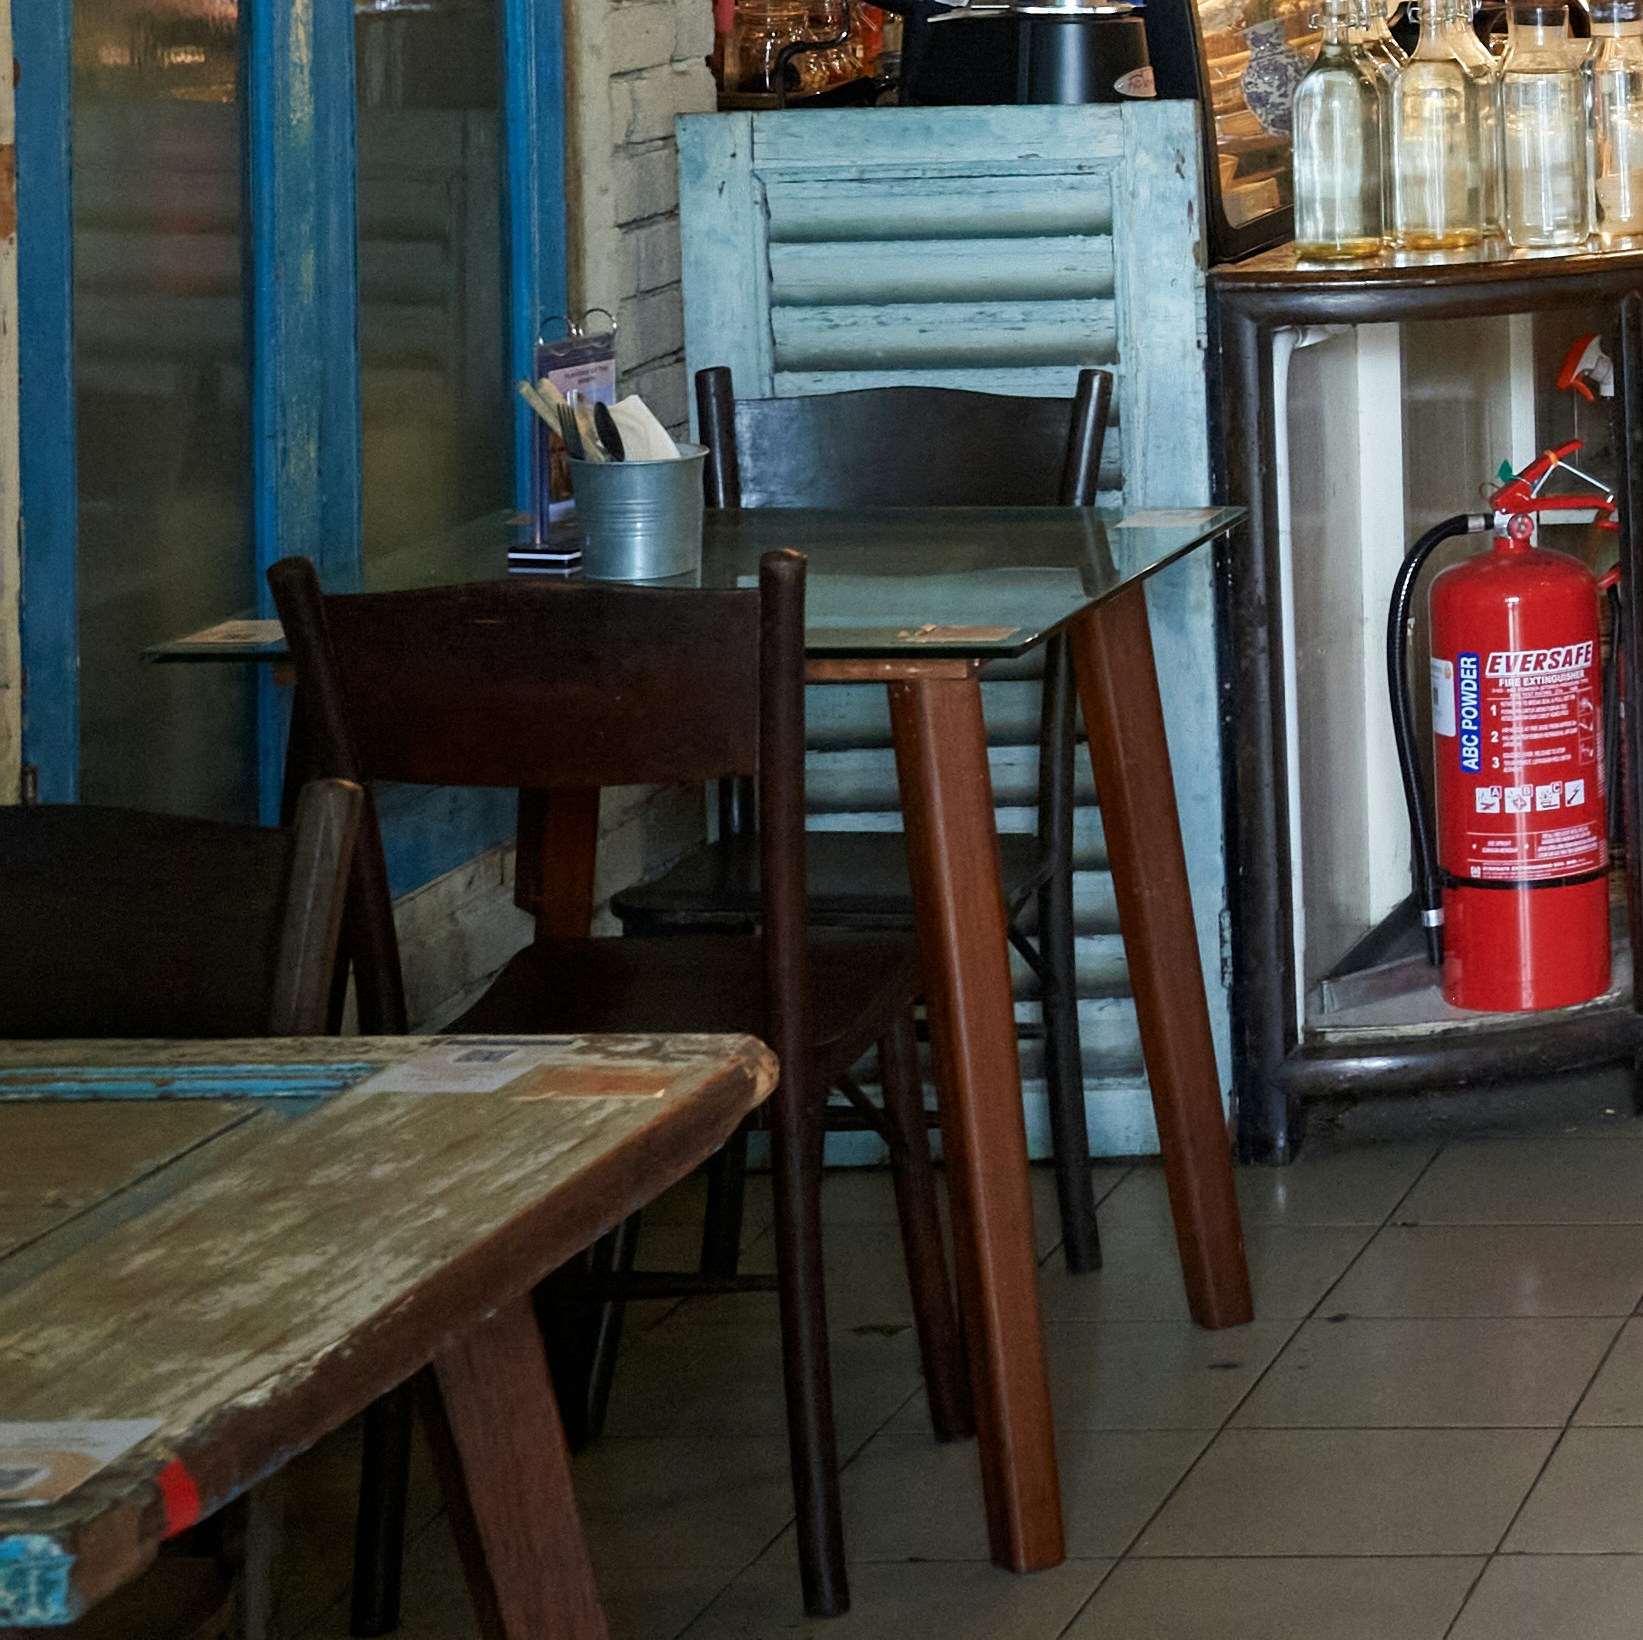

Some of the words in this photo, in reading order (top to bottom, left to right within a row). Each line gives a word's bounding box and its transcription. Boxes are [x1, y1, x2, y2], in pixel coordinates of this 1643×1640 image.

[1487, 643, 1593, 674] EVERSAFE
[1499, 677, 1521, 687] FIRE
[1460, 656, 1479, 730] POWDER
[1490, 704, 1497, 717] 1
[1490, 731, 1499, 743] 2
[1461, 734, 1480, 770] ABC
[1491, 757, 1500, 769] 3
[1491, 786, 1501, 798] A
[1552, 782, 1562, 794] C
